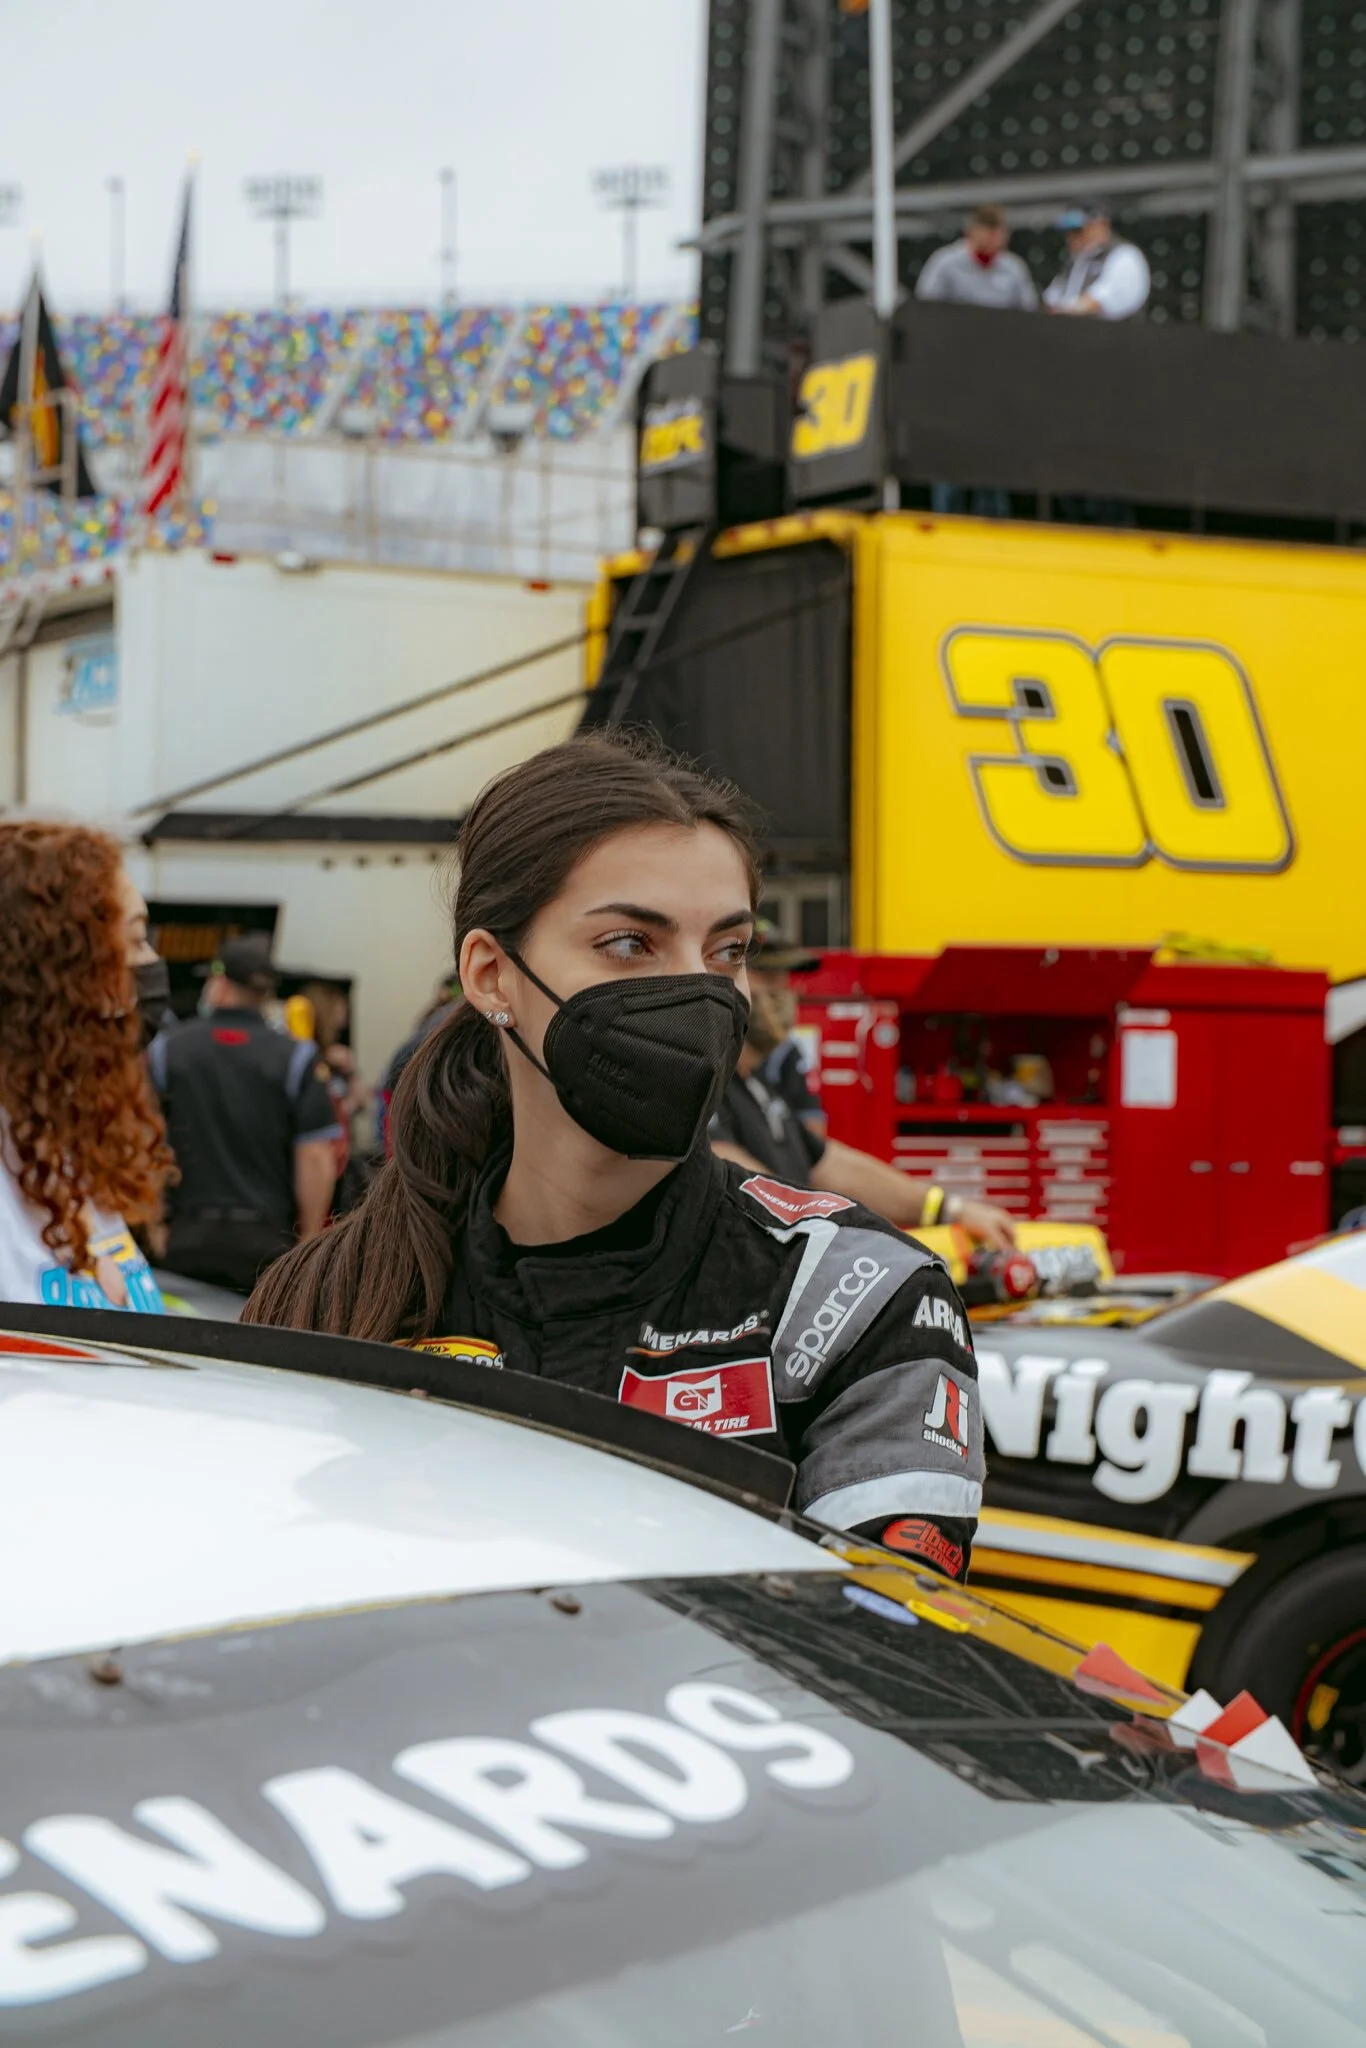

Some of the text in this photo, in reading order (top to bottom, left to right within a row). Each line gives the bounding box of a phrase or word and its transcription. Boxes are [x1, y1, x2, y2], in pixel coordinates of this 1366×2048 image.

[791, 352, 878, 459] 30
[940, 624, 1297, 874] 30
[641, 1313, 760, 1351] MENARDS
[785, 1256, 880, 1379] sparco
[714, 1415, 750, 1431] TIRE
[922, 1428, 963, 1457] shocks
[976, 1350, 1366, 1504] Night
